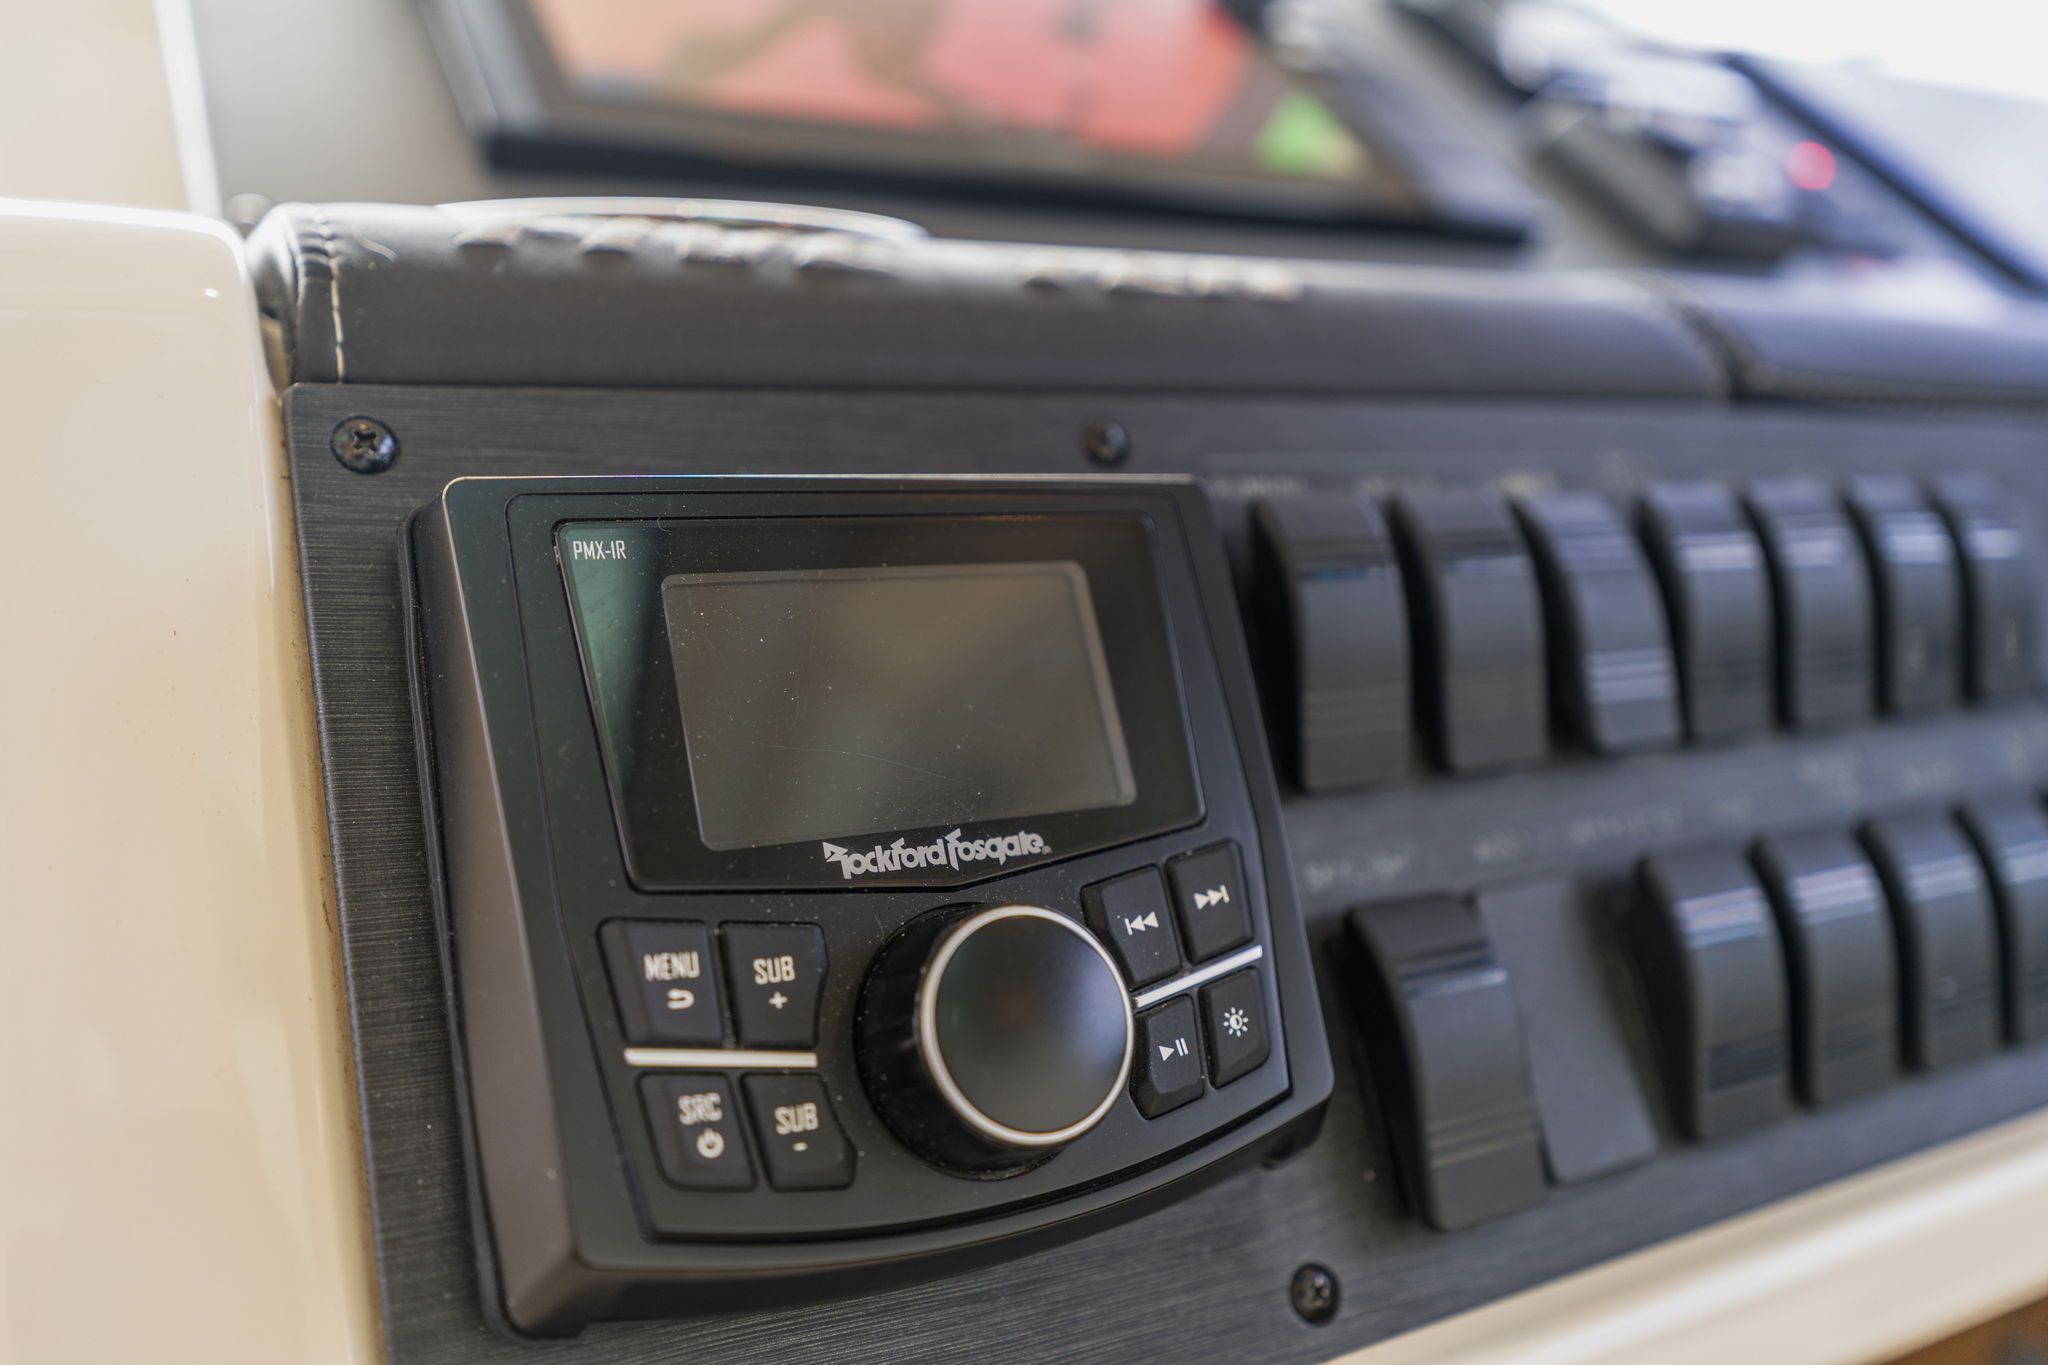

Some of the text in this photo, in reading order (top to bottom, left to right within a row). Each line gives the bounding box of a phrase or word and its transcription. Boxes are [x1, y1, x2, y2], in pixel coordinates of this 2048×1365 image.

[822, 828, 1045, 880] Rockford Fosgate
[643, 951, 701, 982] MENU
[752, 954, 796, 985] SUB
[677, 1092, 723, 1125] SRC
[774, 1102, 820, 1135] SUB
